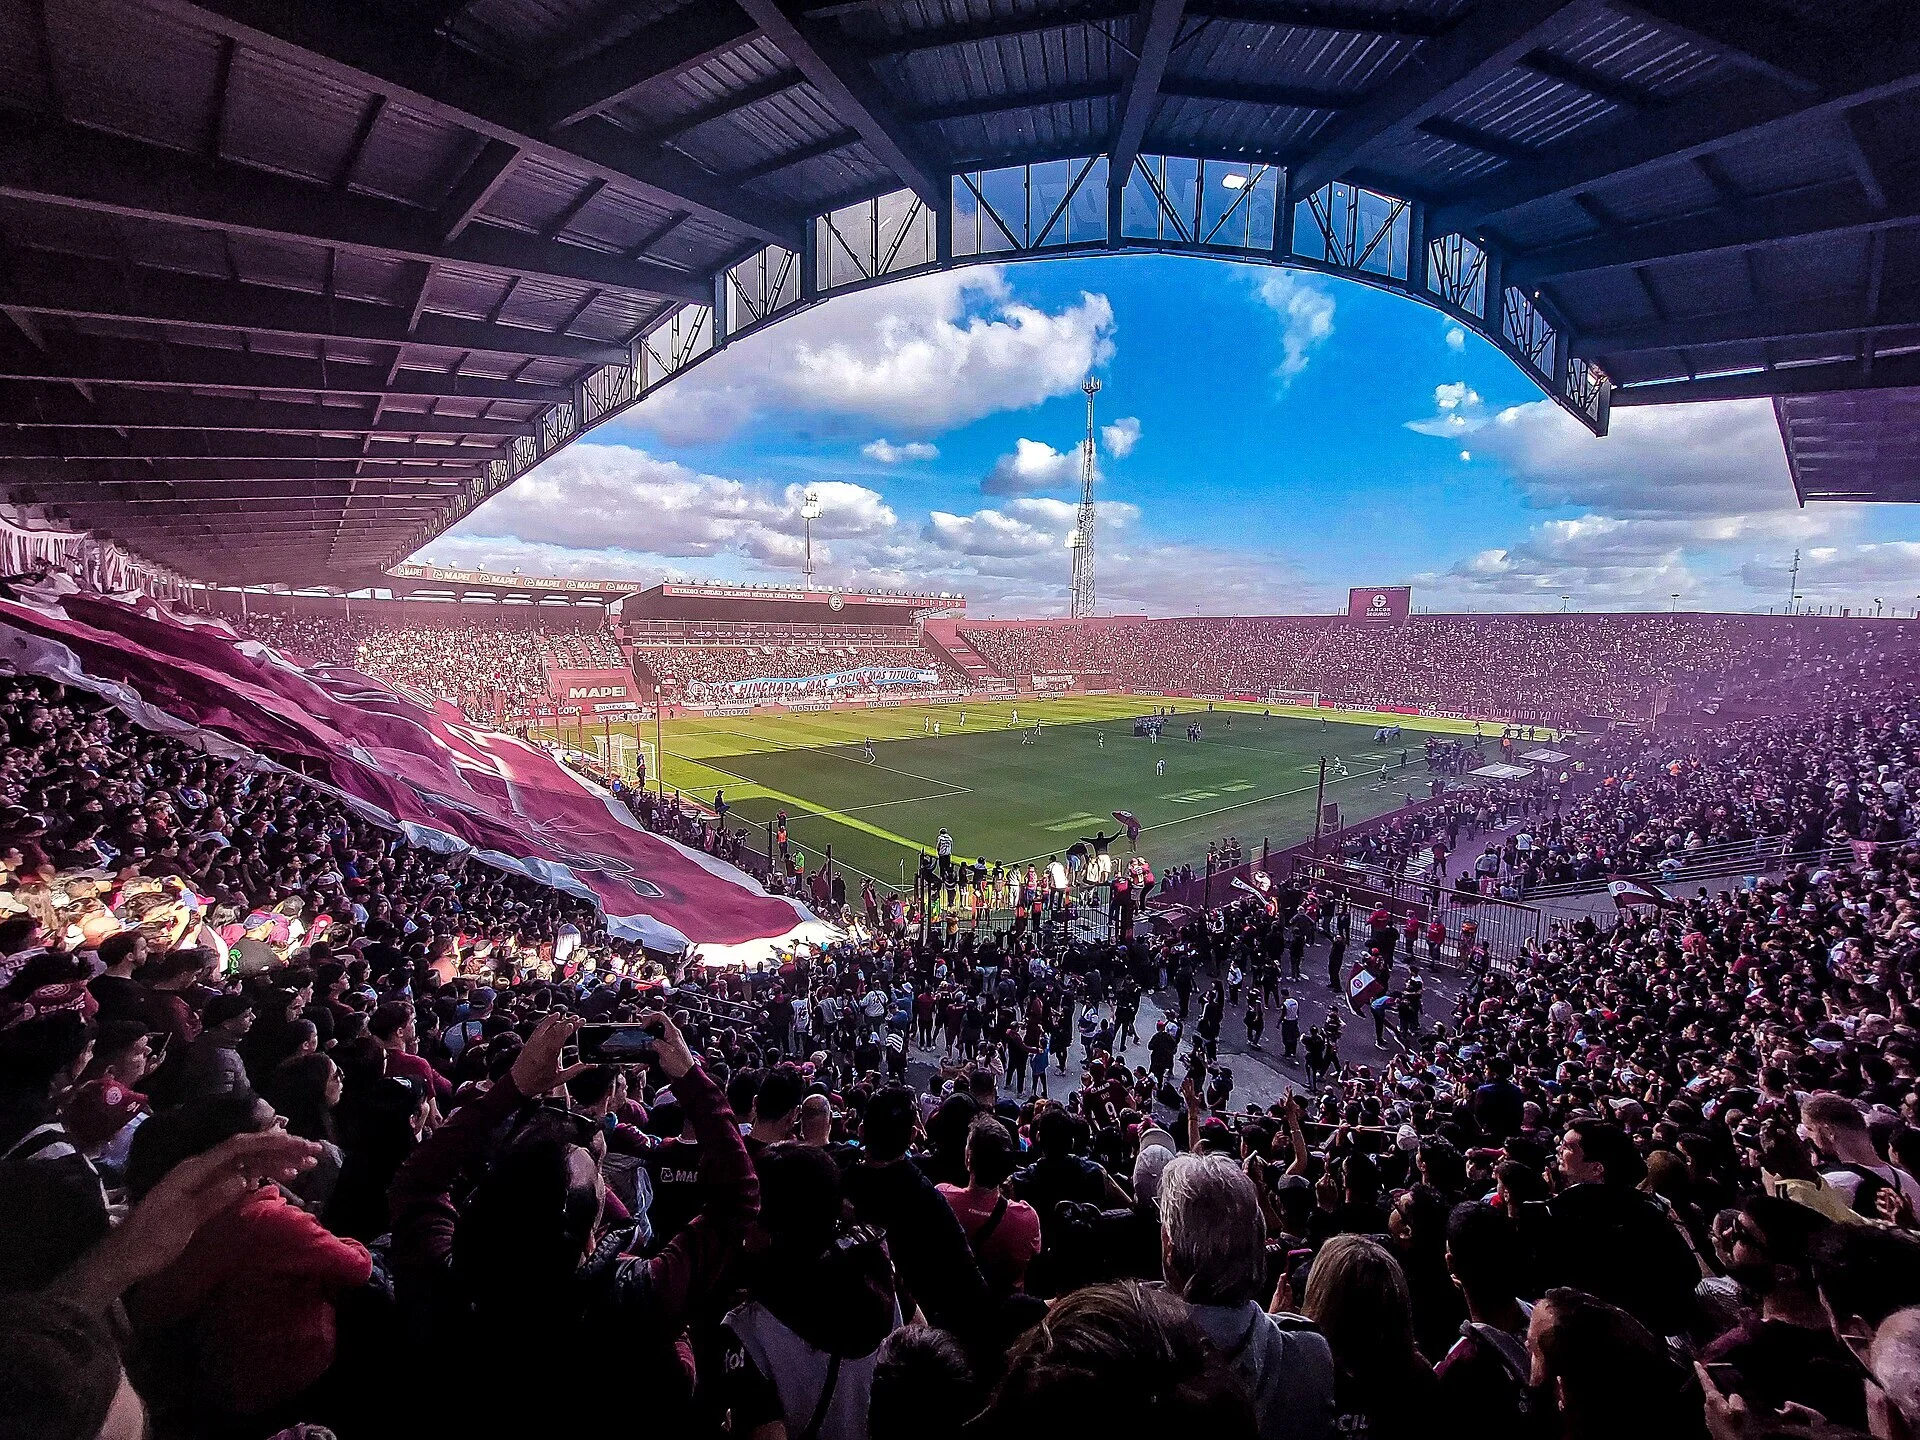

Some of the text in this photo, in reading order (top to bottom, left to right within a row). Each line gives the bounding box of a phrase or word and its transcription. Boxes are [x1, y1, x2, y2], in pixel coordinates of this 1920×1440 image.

[444, 572, 471, 580] MAPEI
[491, 576, 518, 585] MAPEI
[535, 579, 561, 588] MAPEI
[577, 581, 601, 590] MAPEI
[616, 583, 639, 591] MAPEI
[569, 687, 627, 699] MAPEI
[740, 681, 800, 698] HINCHADA
[1504, 709, 1536, 720] MANDO
